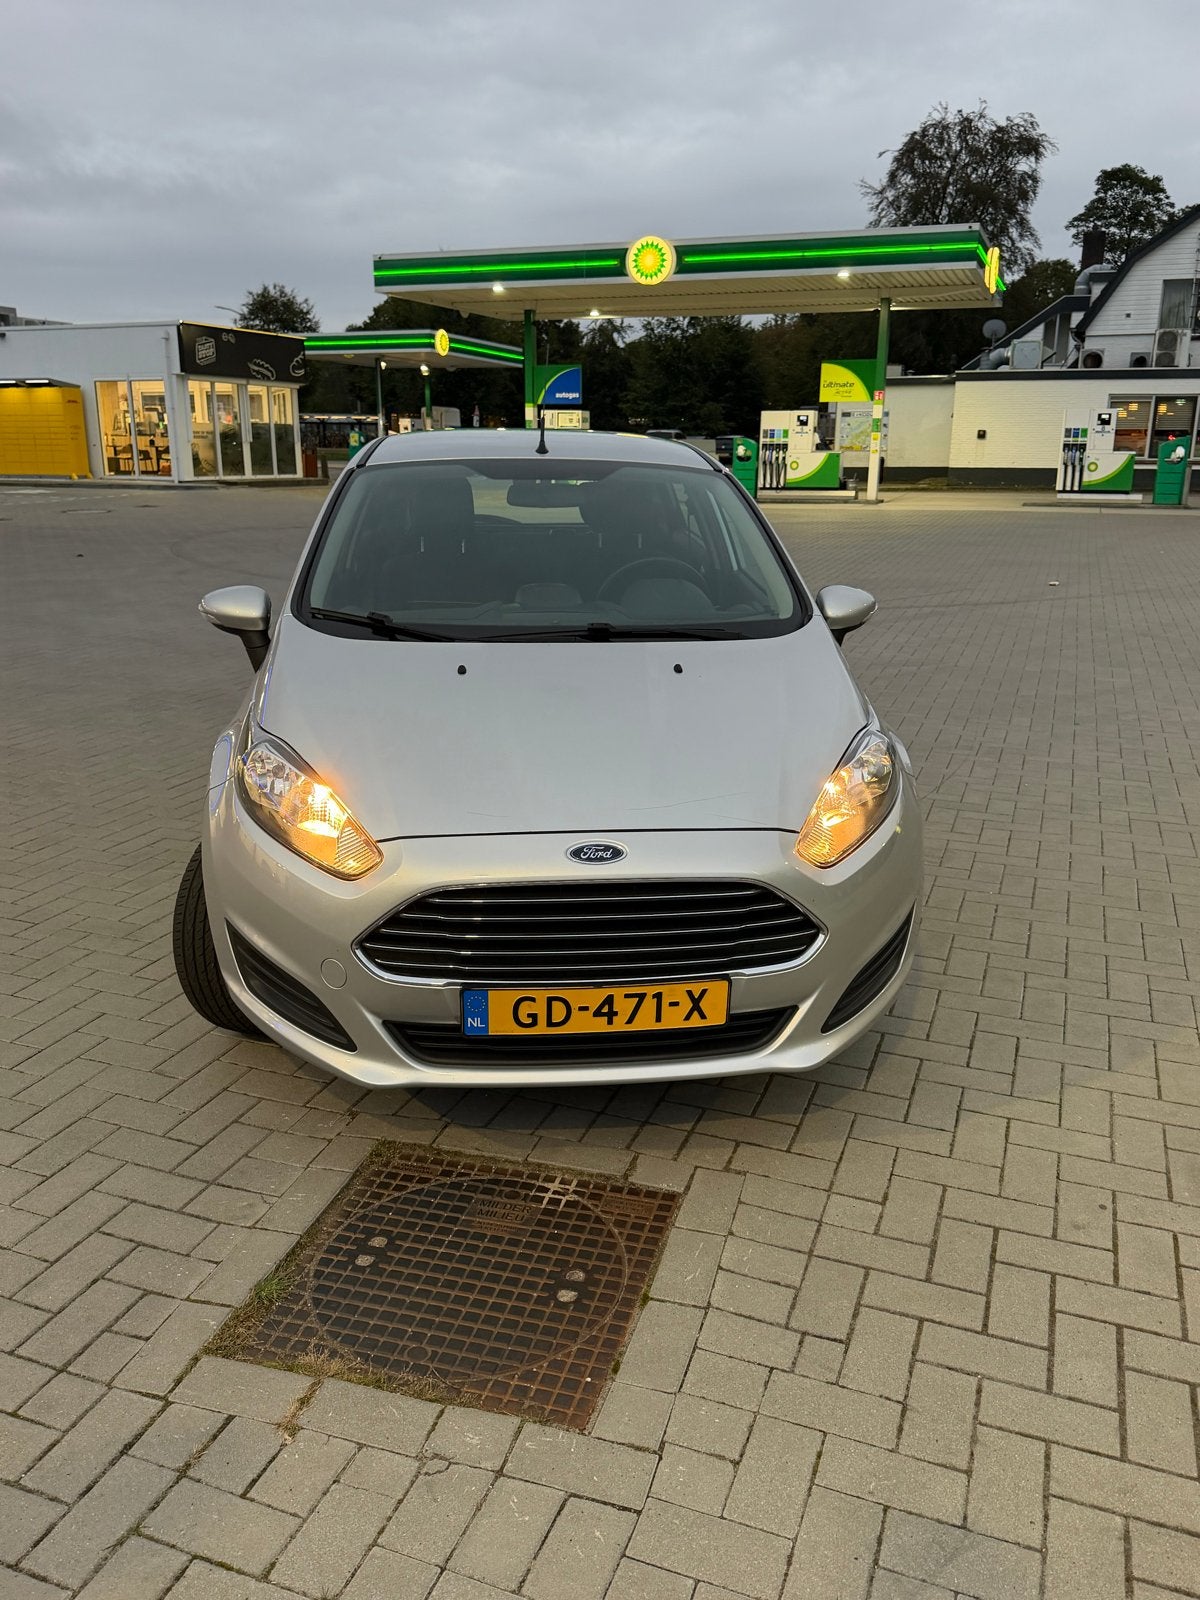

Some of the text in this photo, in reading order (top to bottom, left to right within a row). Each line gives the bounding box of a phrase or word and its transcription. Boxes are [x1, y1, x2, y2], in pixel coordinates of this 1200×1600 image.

[580, 846, 613, 859] Ford
[512, 988, 709, 1029] GD-471-X
[467, 1017, 486, 1028] NL
[479, 1200, 531, 1213] MILDER
[477, 1209, 525, 1222] MILIEU
